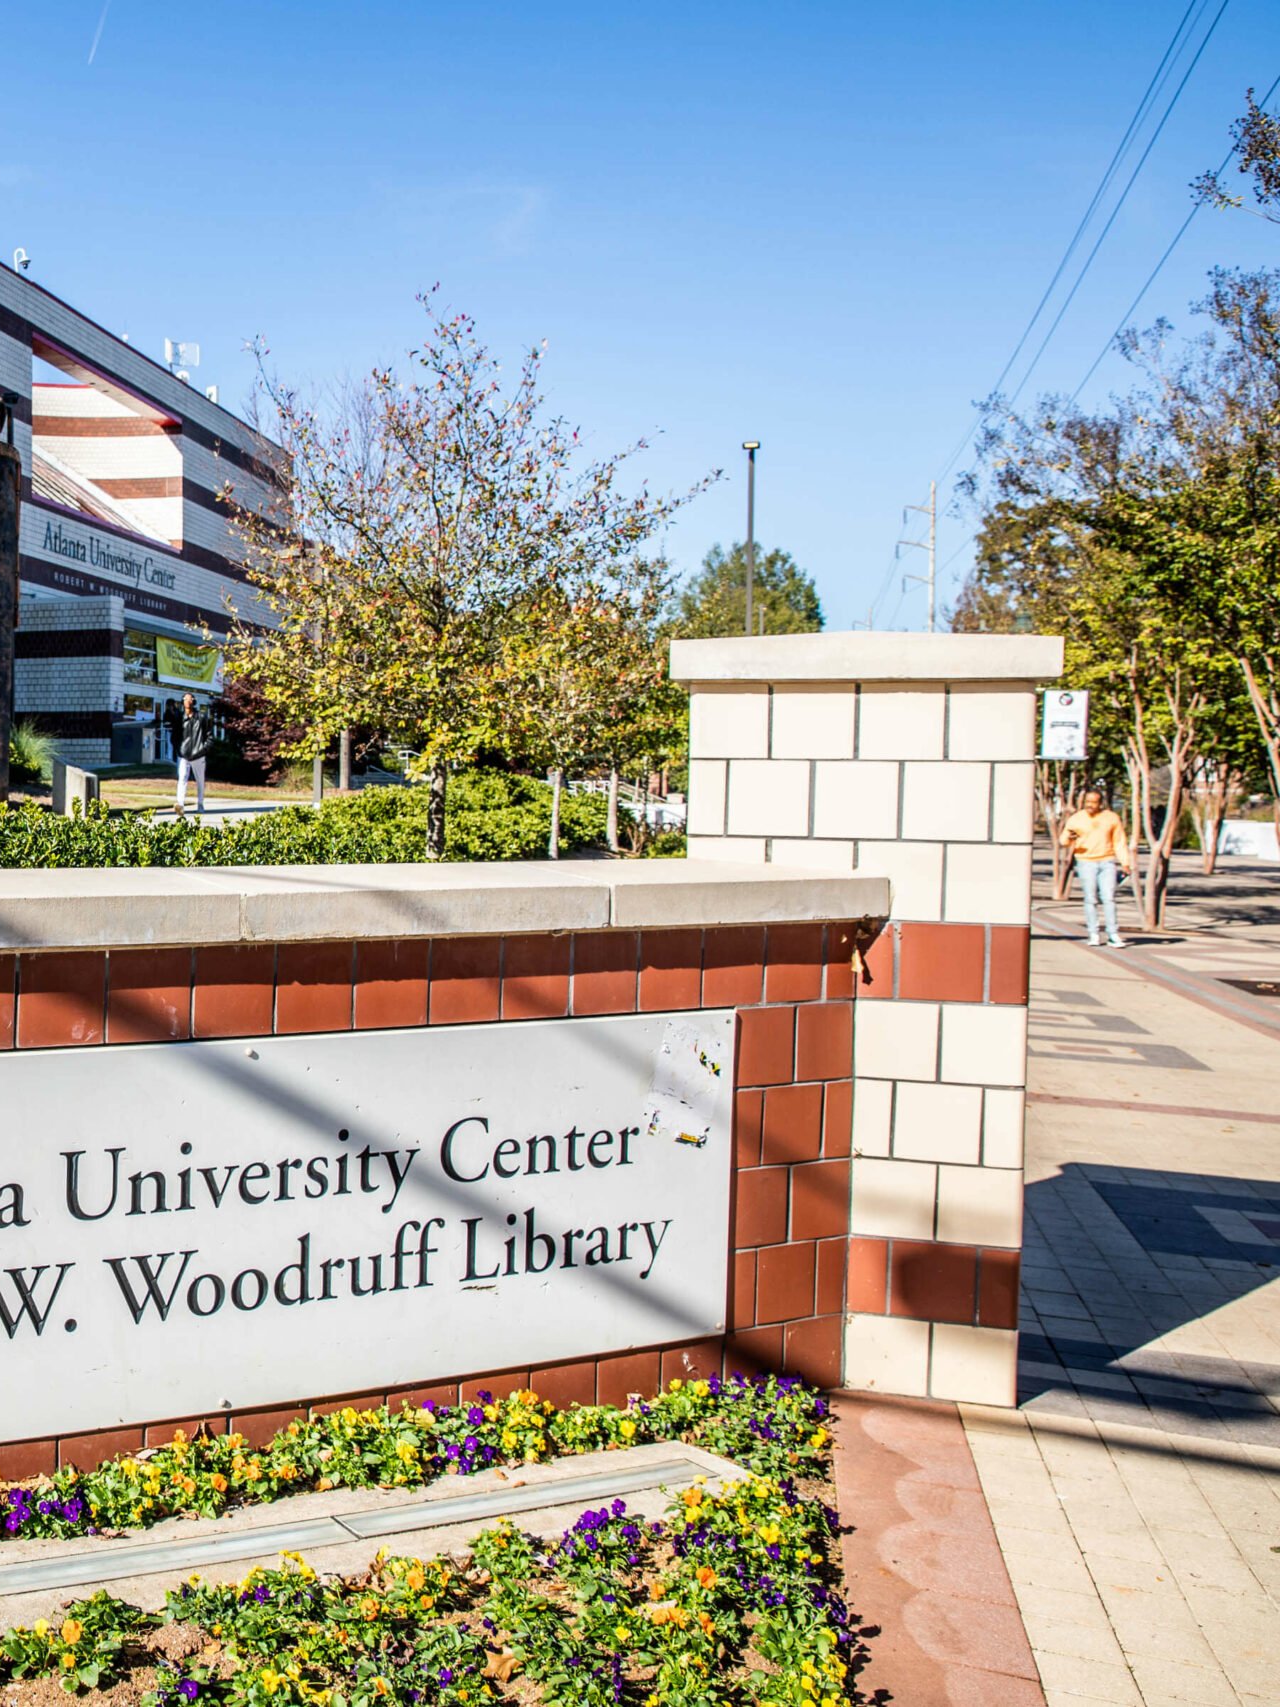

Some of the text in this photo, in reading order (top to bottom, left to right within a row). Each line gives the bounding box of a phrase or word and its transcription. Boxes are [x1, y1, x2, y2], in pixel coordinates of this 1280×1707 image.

[43, 520, 176, 591] Atlanta University Center
[53, 571, 84, 588] ROBERT
[139, 596, 167, 611] LIBRARY
[59, 1127, 421, 1215] University
[440, 1116, 641, 1184] Center
[102, 1217, 445, 1326] Woodruff
[458, 1206, 673, 1283] Library
